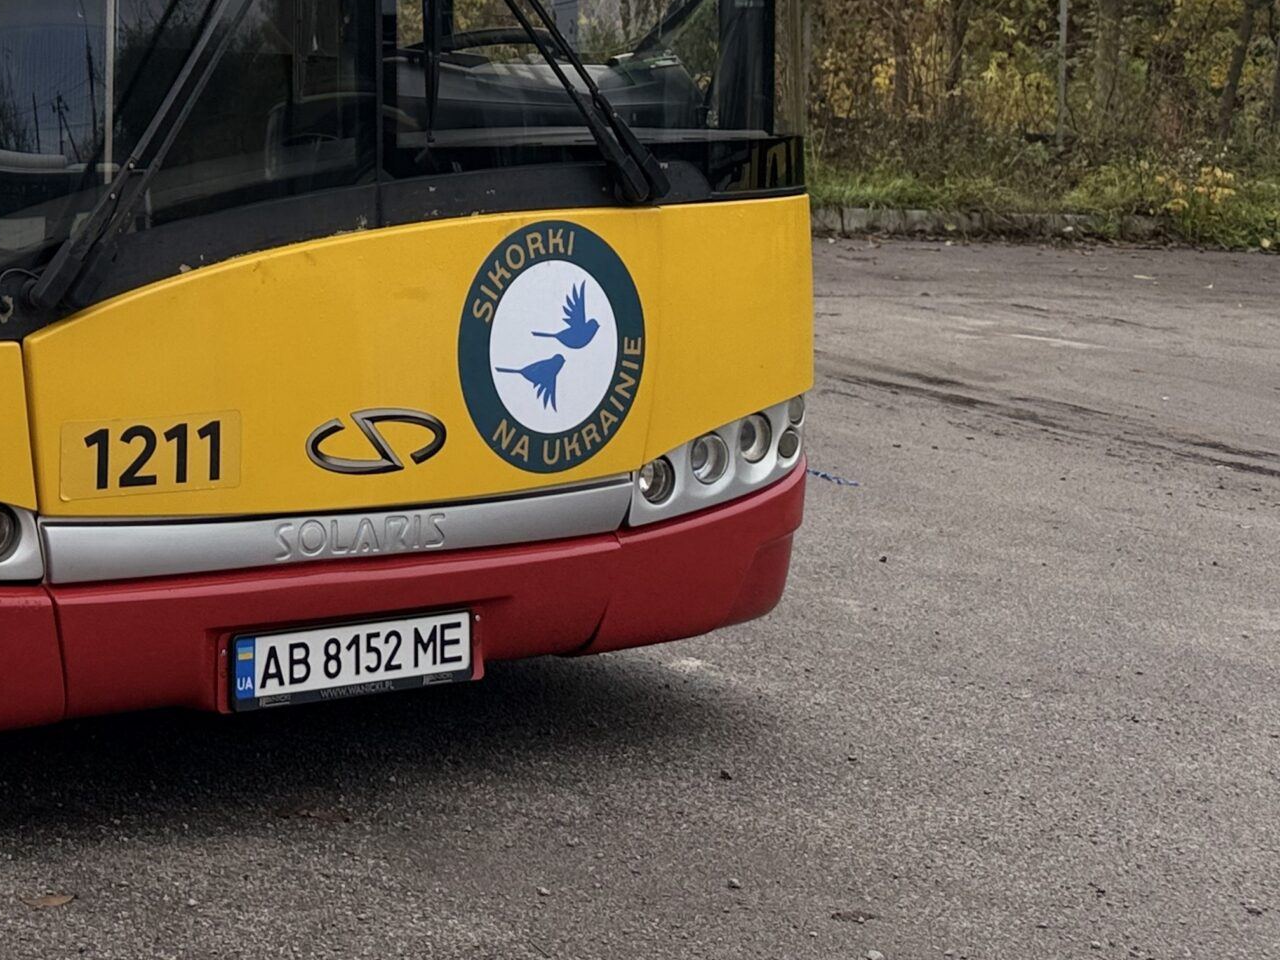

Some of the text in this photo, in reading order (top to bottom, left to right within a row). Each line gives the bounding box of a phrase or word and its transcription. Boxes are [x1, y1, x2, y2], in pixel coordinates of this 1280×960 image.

[472, 228, 576, 323] SIKORKI
[492, 336, 642, 465] NA UKRAINIE
[84, 420, 221, 490] 1211
[274, 512, 446, 561] SOLARIS
[236, 677, 254, 690] UA
[259, 621, 463, 689] AB 8152 ME
